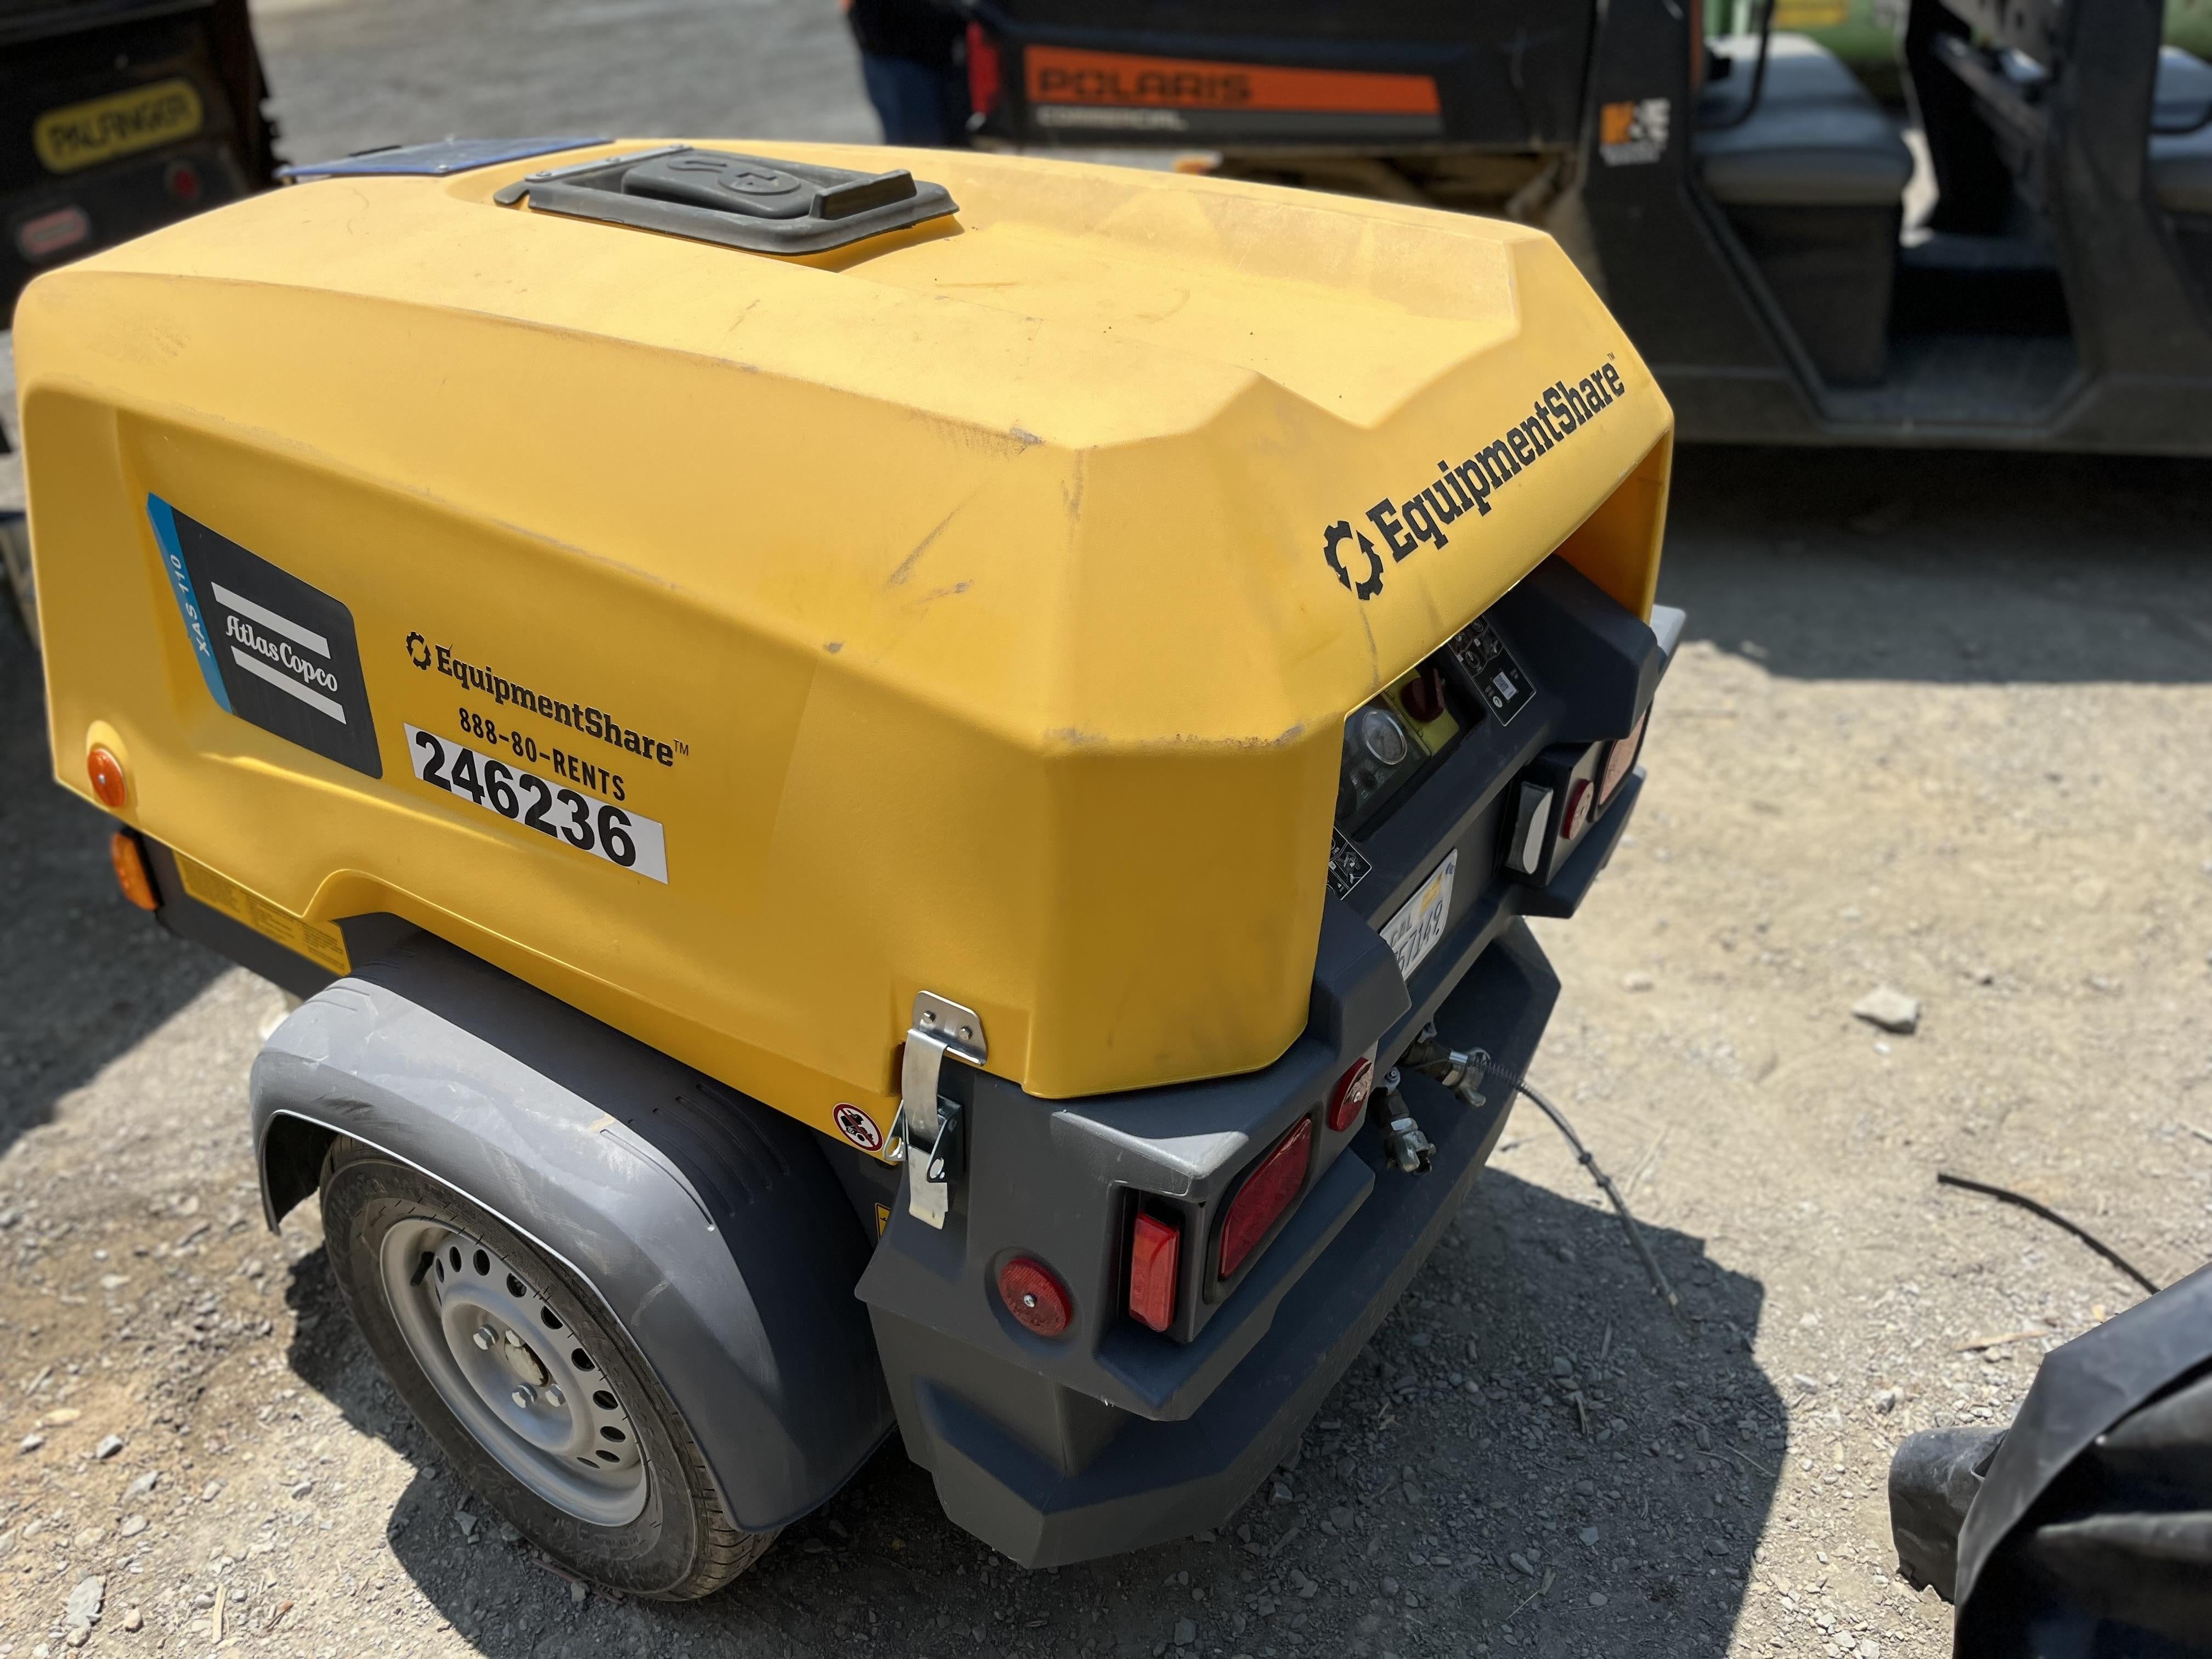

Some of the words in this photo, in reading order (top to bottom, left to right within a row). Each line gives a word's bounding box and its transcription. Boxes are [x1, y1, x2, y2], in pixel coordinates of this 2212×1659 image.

[1039, 68, 1252, 103] POLARIS
[170, 555, 192, 594] 110
[185, 604, 210, 657] XAS
[225, 614, 280, 662] Atlas
[279, 642, 338, 692] Copco
[459, 707, 626, 801] 888-80-RENTS
[415, 731, 636, 868] 246236
